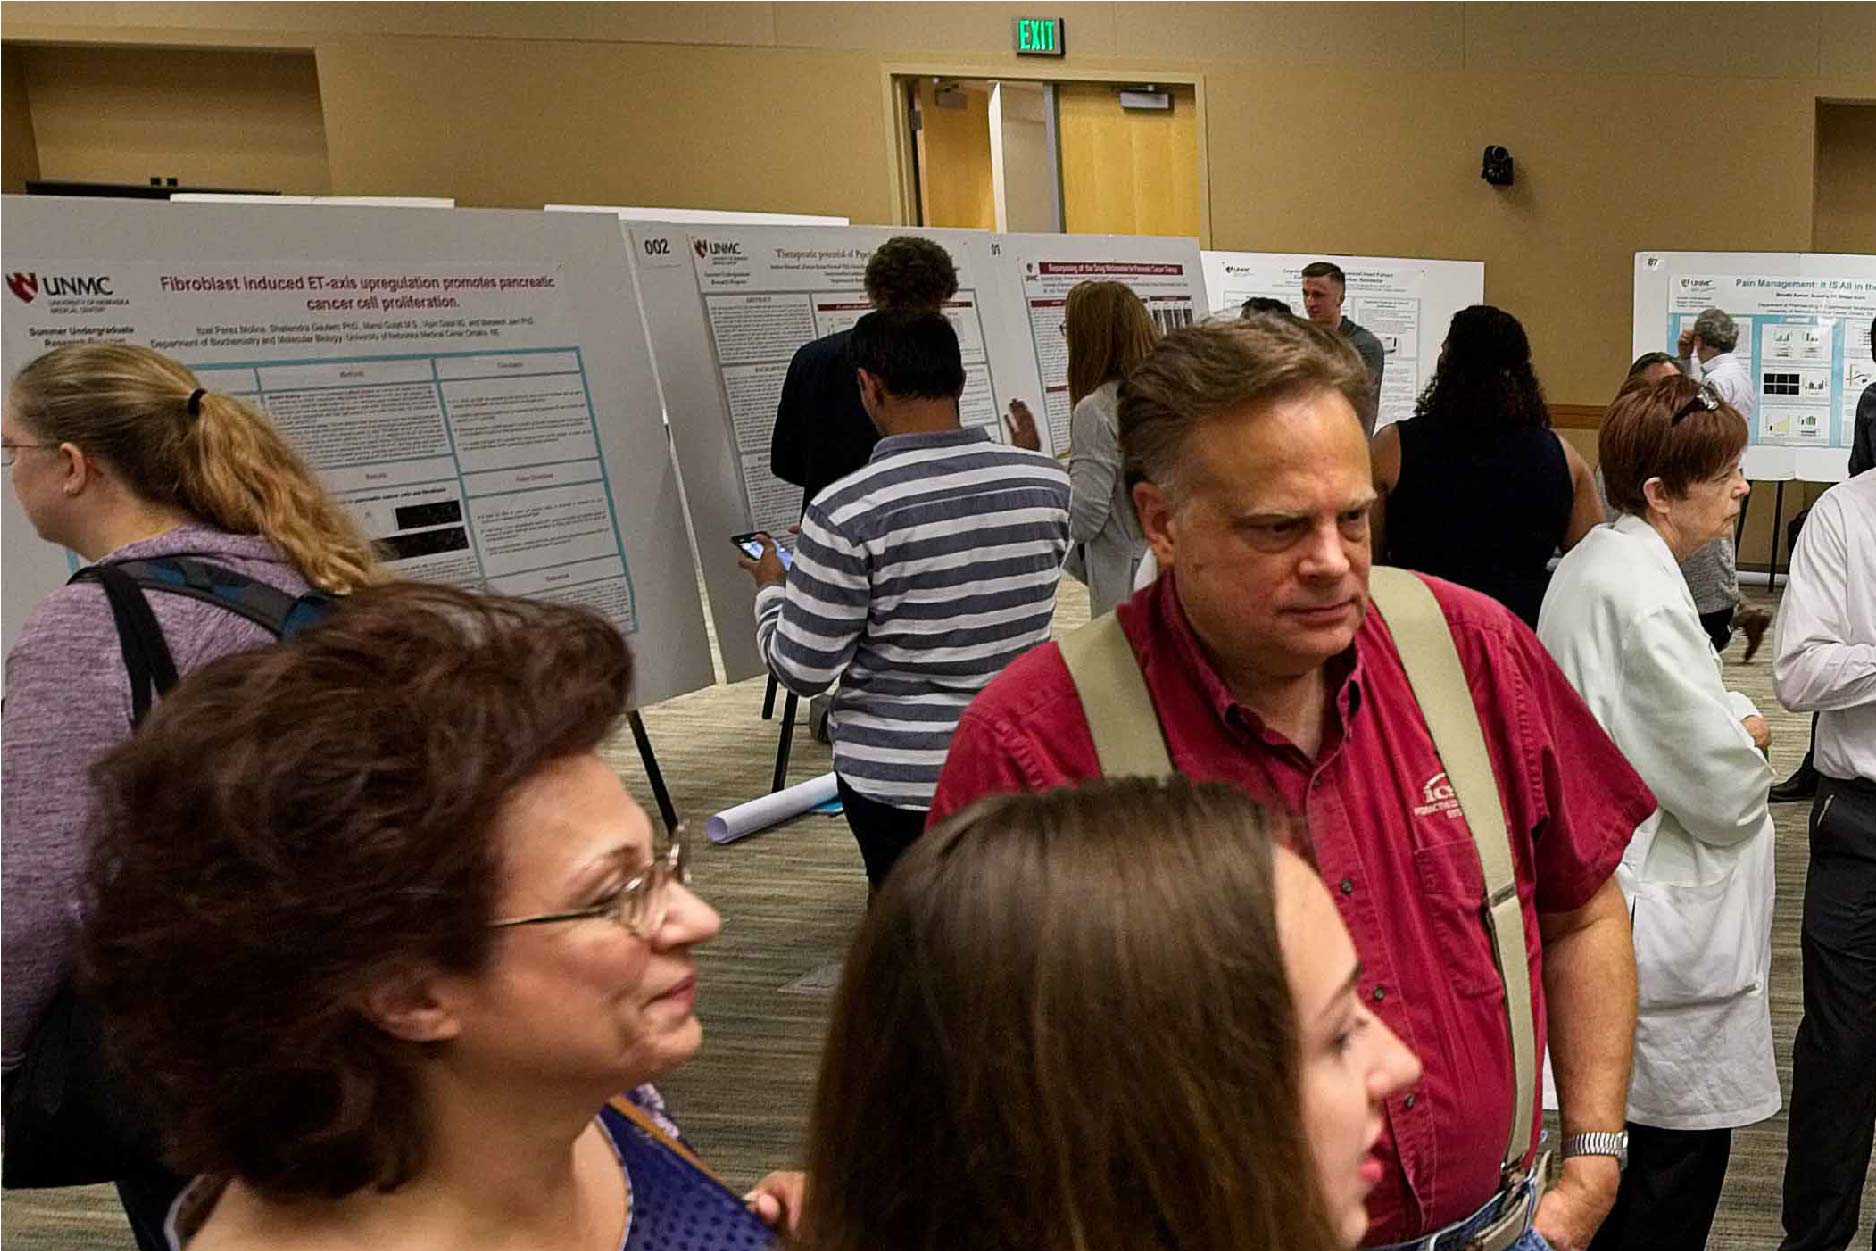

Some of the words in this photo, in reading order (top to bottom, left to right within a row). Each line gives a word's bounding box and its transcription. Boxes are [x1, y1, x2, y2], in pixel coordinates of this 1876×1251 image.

[1019, 19, 1055, 50] EXIT
[644, 238, 670, 256] 002
[43, 276, 114, 297] UNMC
[160, 275, 239, 292] Fibroblast
[360, 274, 440, 293] upregulation
[443, 275, 497, 291] promotes
[499, 275, 555, 291] pancreatic
[1735, 278, 1757, 288] Pain
[306, 297, 354, 311] cancer
[356, 296, 379, 310] cell
[382, 294, 461, 312] proliferation.
